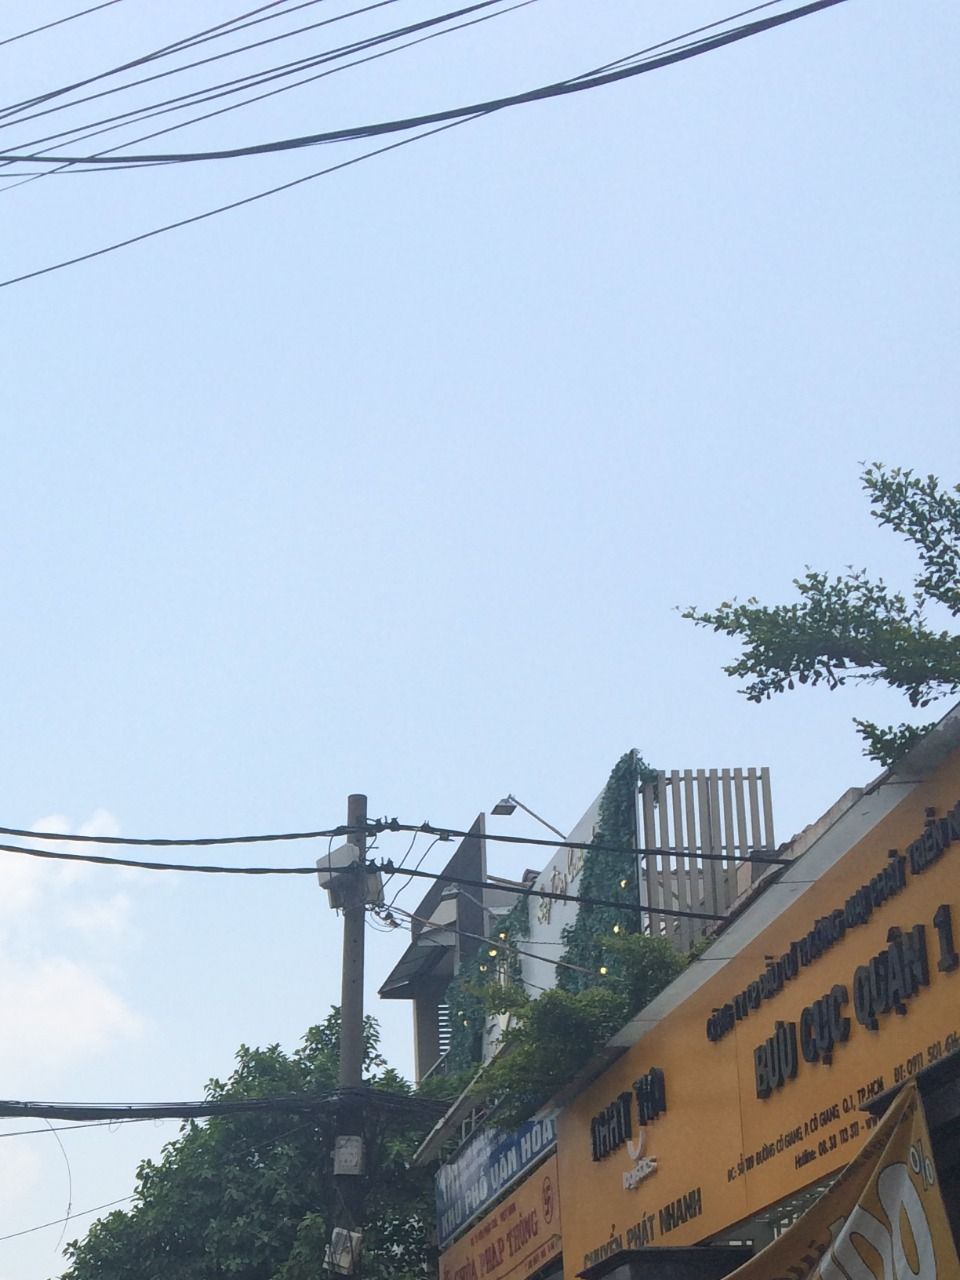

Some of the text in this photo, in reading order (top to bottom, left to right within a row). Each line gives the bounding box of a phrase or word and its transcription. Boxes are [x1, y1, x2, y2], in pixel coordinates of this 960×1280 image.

[853, 924, 930, 1030] QUẬN
[933, 904, 959, 972] 1
[465, 1166, 489, 1215] PHỐ
[658, 1187, 703, 1236] NHANH
